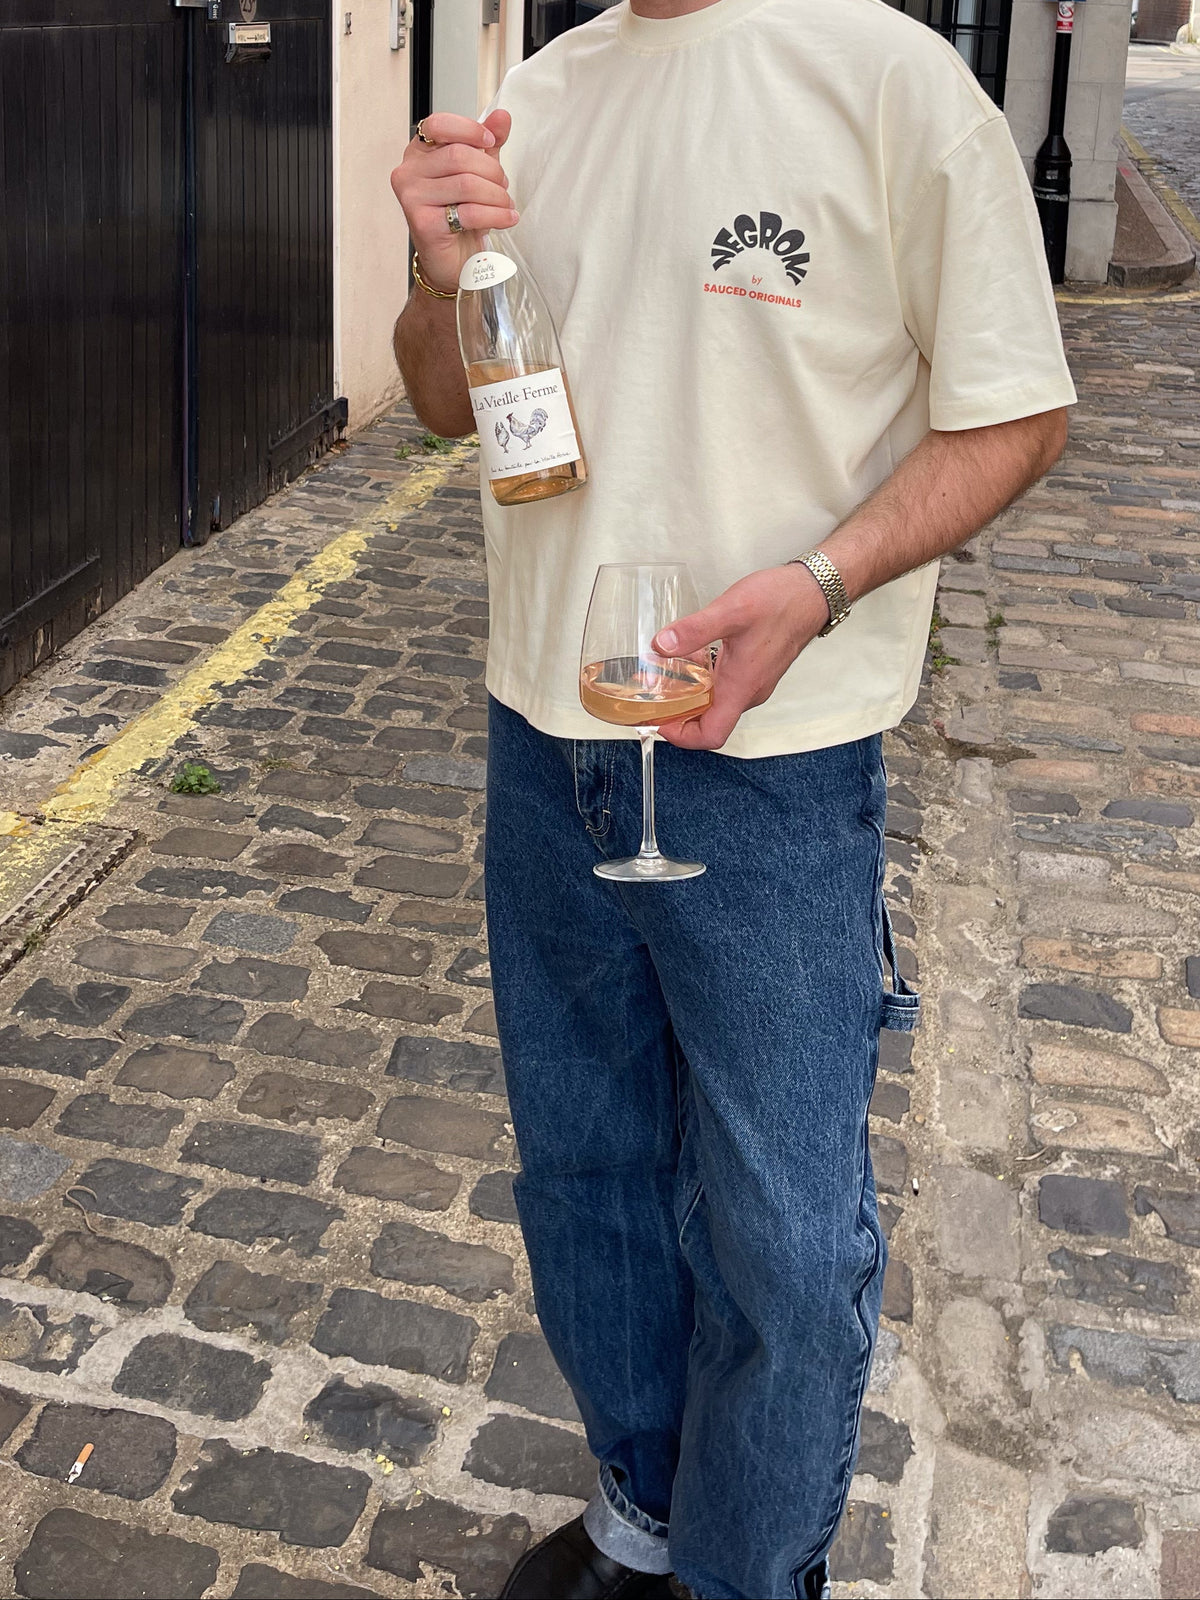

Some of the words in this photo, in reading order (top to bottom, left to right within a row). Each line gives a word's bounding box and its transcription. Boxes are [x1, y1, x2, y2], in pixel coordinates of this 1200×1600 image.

[710, 211, 811, 286] NEGRONI
[751, 275, 763, 285] by
[703, 283, 747, 297] SAUCED
[748, 290, 802, 308] ORIGINALS
[474, 398, 485, 411] La
[484, 391, 519, 408] Vieille
[522, 384, 558, 400] Ferme
